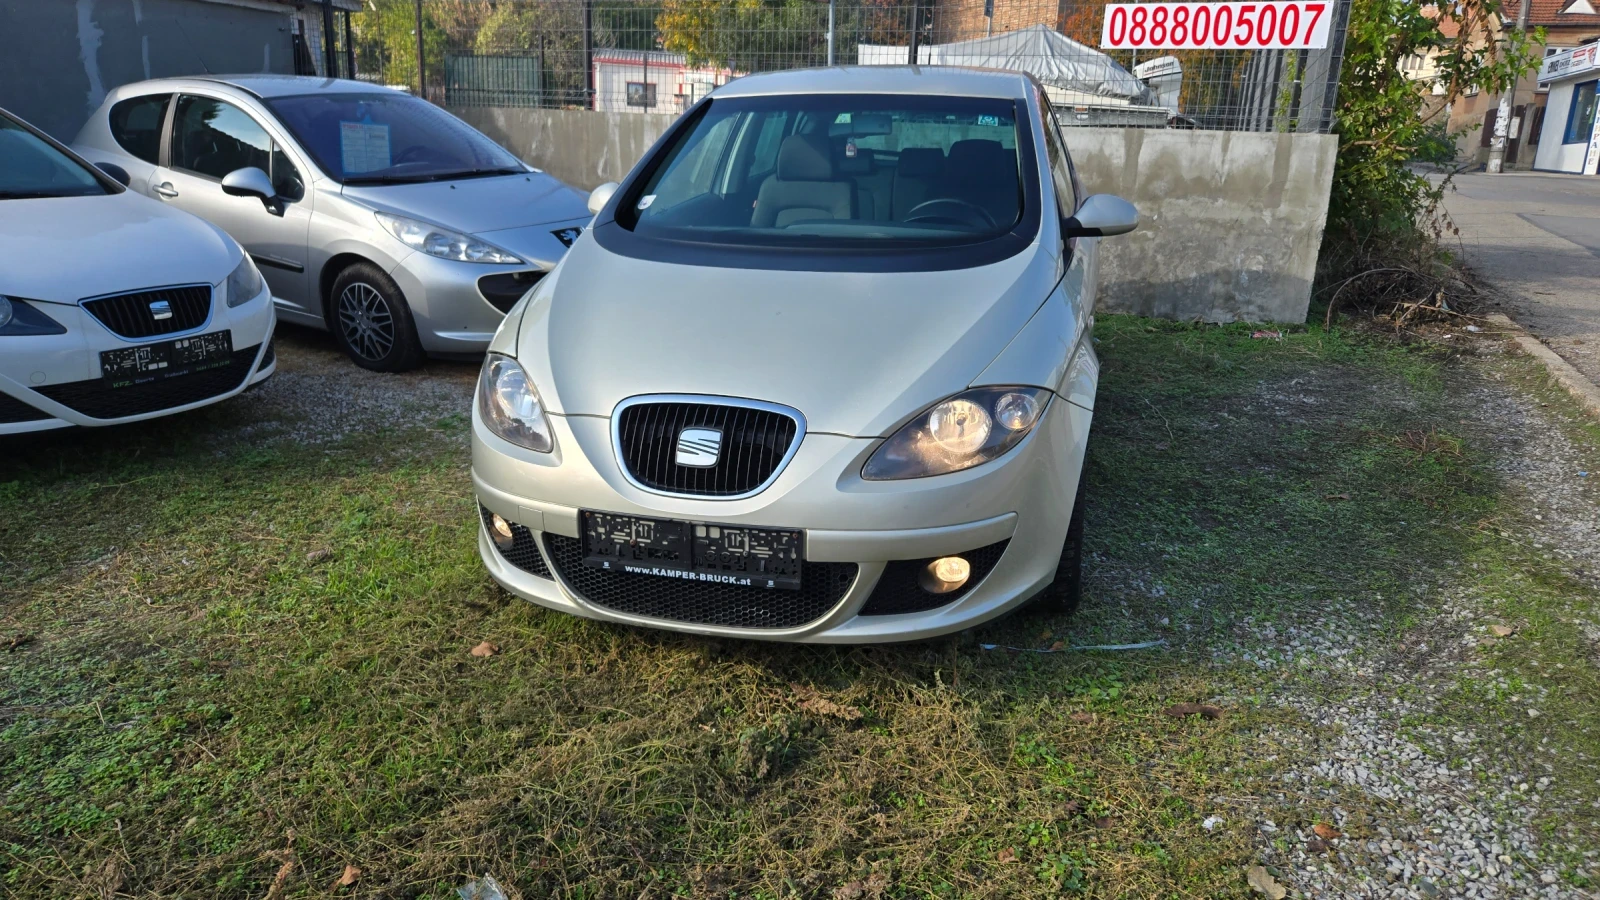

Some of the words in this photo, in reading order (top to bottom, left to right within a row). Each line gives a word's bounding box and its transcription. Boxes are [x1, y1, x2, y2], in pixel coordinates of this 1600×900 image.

[1109, 4, 1325, 46] 0888005007
[1145, 62, 1174, 72] Johnson
[625, 565, 751, 586] www.KAMPER-BRUCK.at
